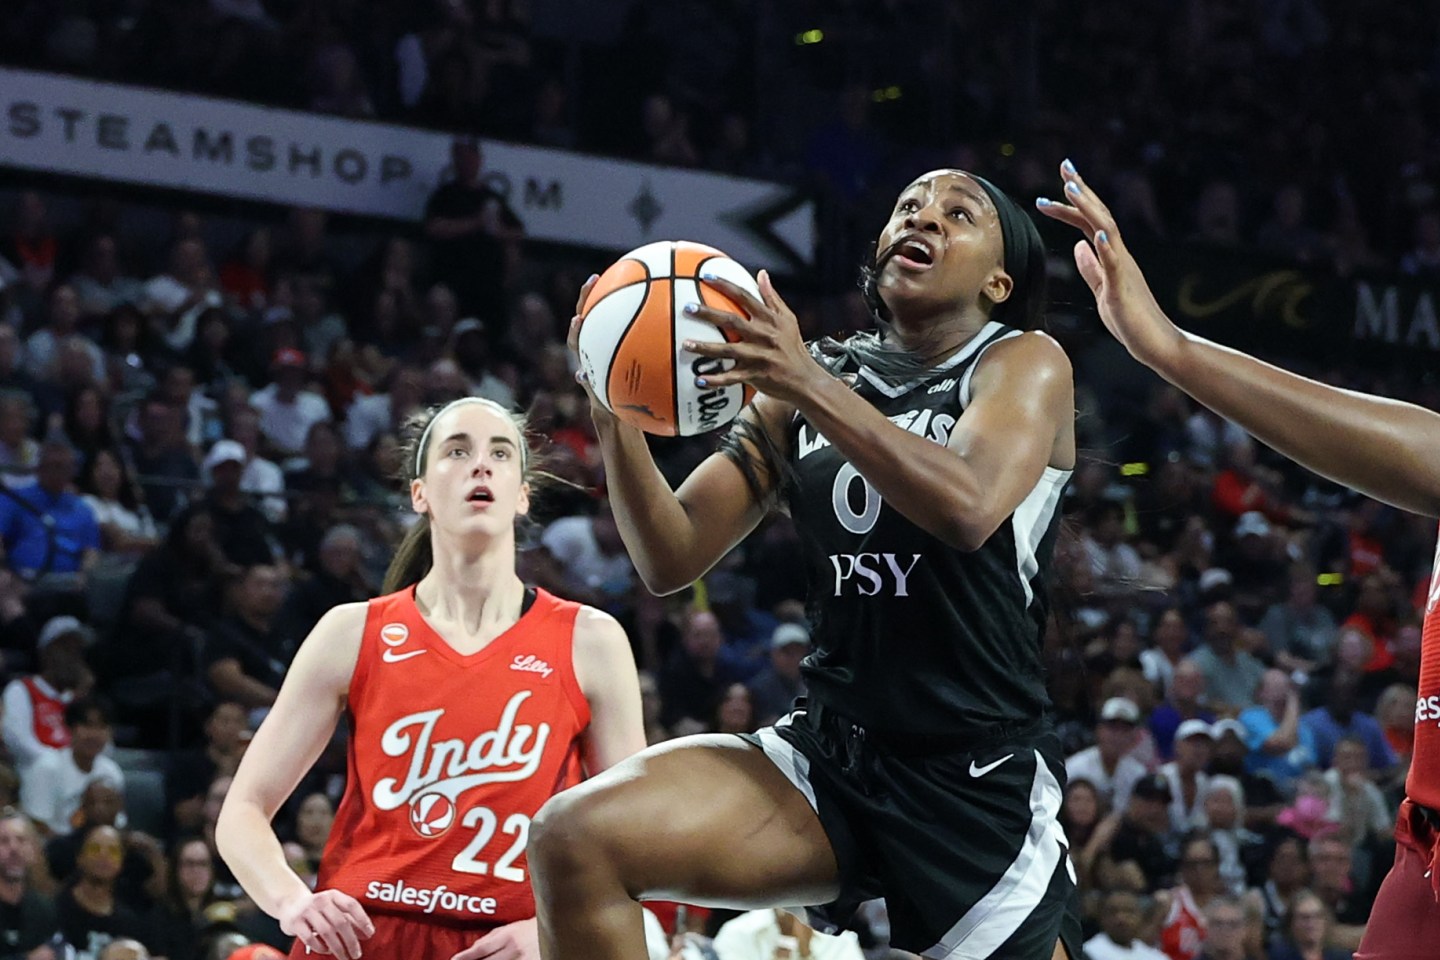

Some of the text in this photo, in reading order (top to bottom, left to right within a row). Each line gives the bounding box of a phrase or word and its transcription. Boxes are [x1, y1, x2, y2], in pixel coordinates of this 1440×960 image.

[832, 461, 881, 534] 0
[829, 553, 921, 597] PSY
[510, 654, 554, 679] Lilly
[372, 690, 550, 811] Indy
[451, 806, 532, 882] 22
[365, 879, 497, 915] salesforce
